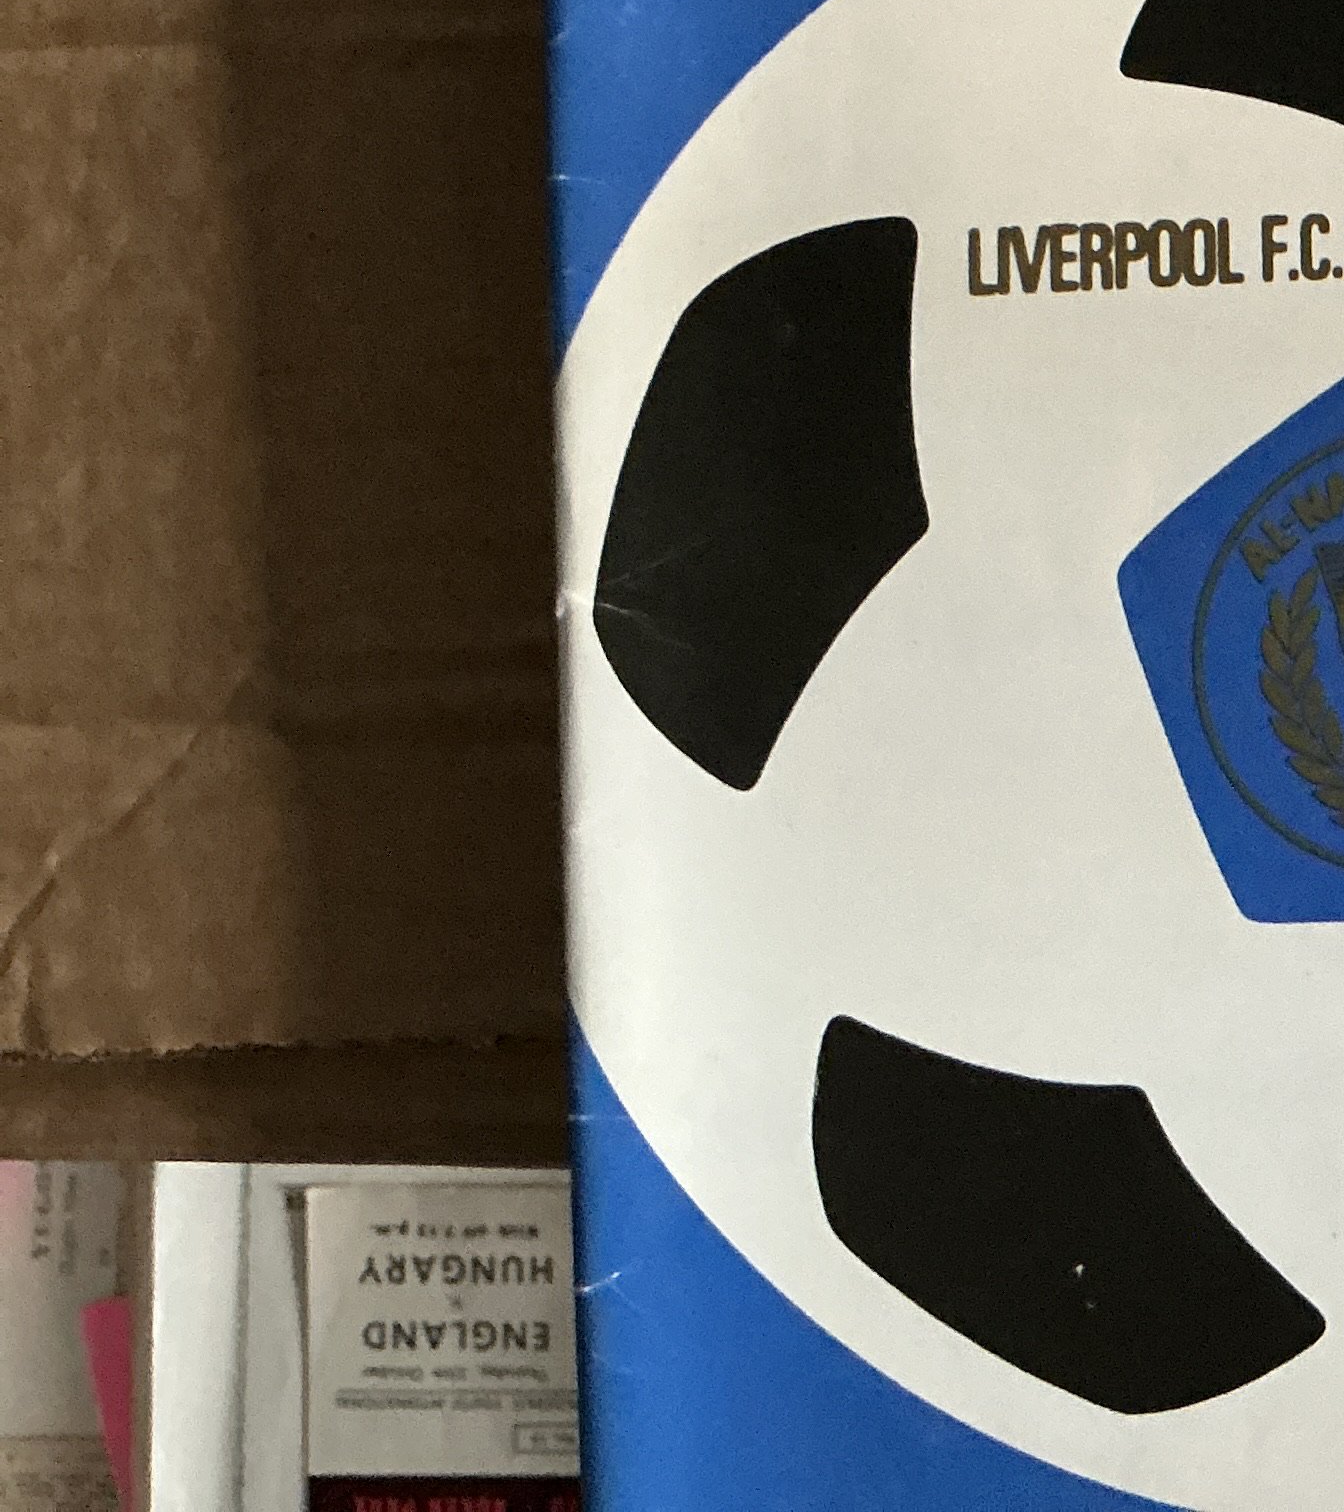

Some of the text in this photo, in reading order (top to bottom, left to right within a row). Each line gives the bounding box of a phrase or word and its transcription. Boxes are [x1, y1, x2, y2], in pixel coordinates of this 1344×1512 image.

[967, 217, 1244, 297] LIVERPOOL
[1261, 213, 1344, 284] F.C.
[358, 1254, 555, 1286] HUNGARY
[361, 1320, 551, 1352] ENGLAND
